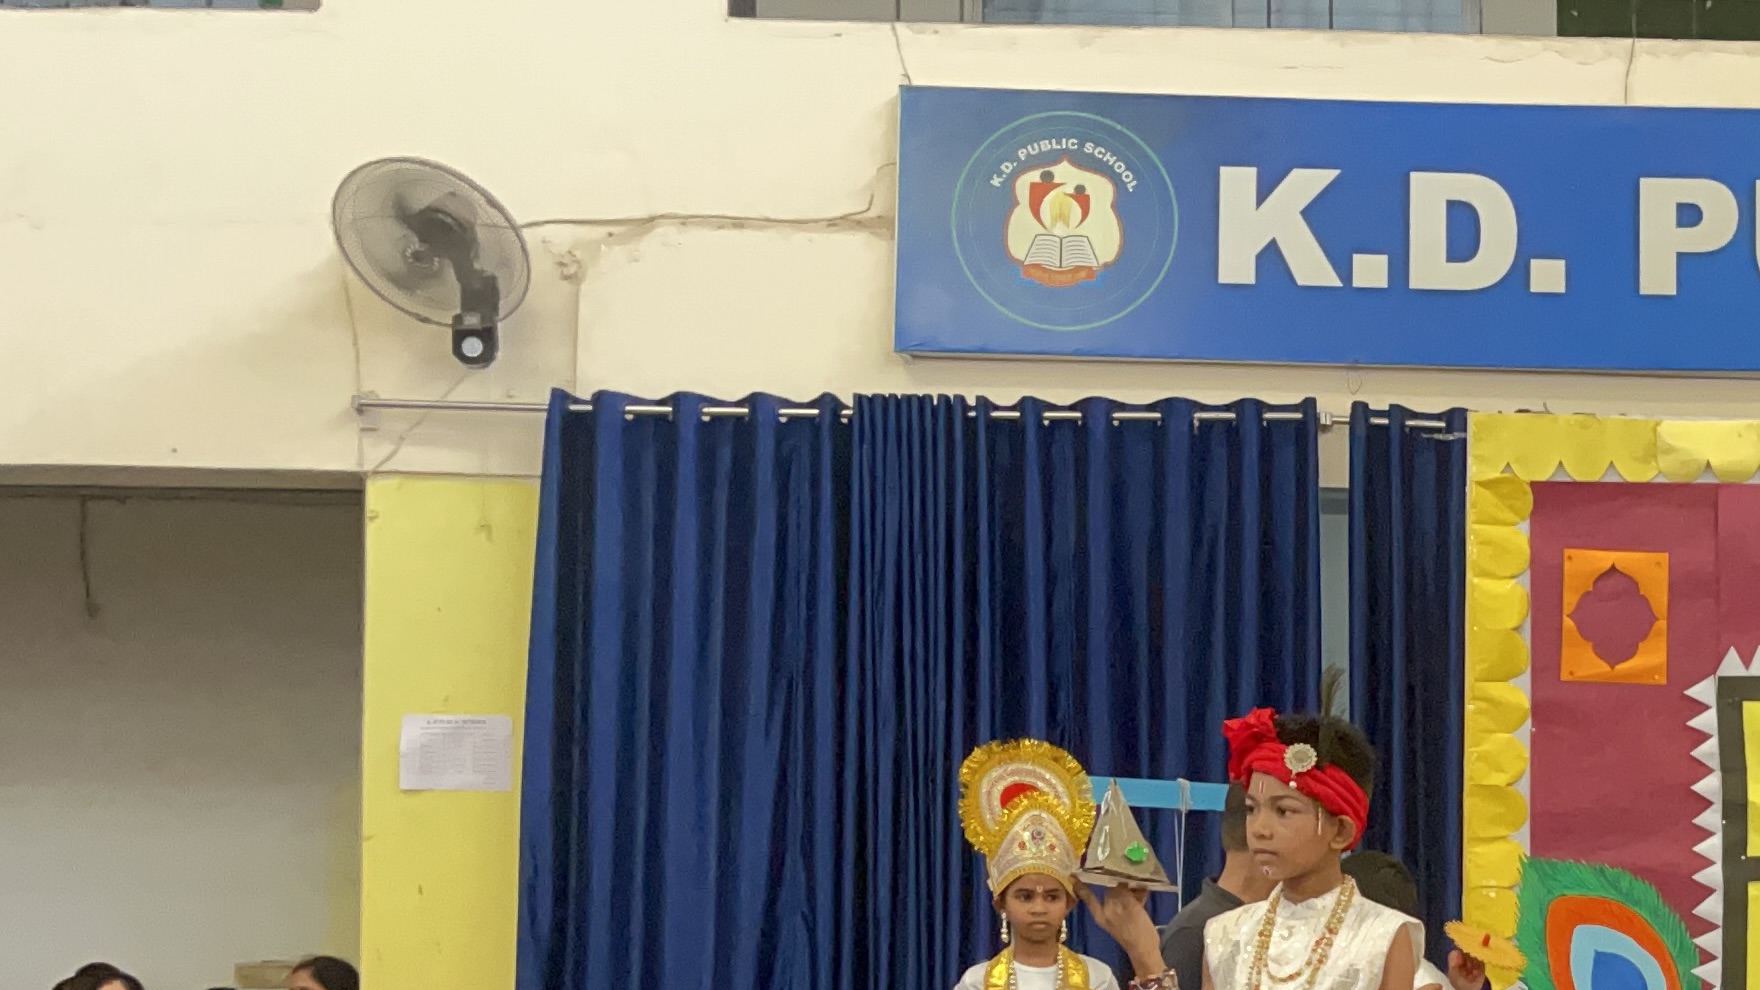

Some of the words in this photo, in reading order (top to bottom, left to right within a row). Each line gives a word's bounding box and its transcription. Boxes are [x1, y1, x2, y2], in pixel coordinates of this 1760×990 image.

[990, 161, 1018, 187] K.D.
[1017, 138, 1079, 161] PUBLIC
[1083, 142, 1138, 193] SCHOOL
[1217, 165, 1566, 293] K.D.
